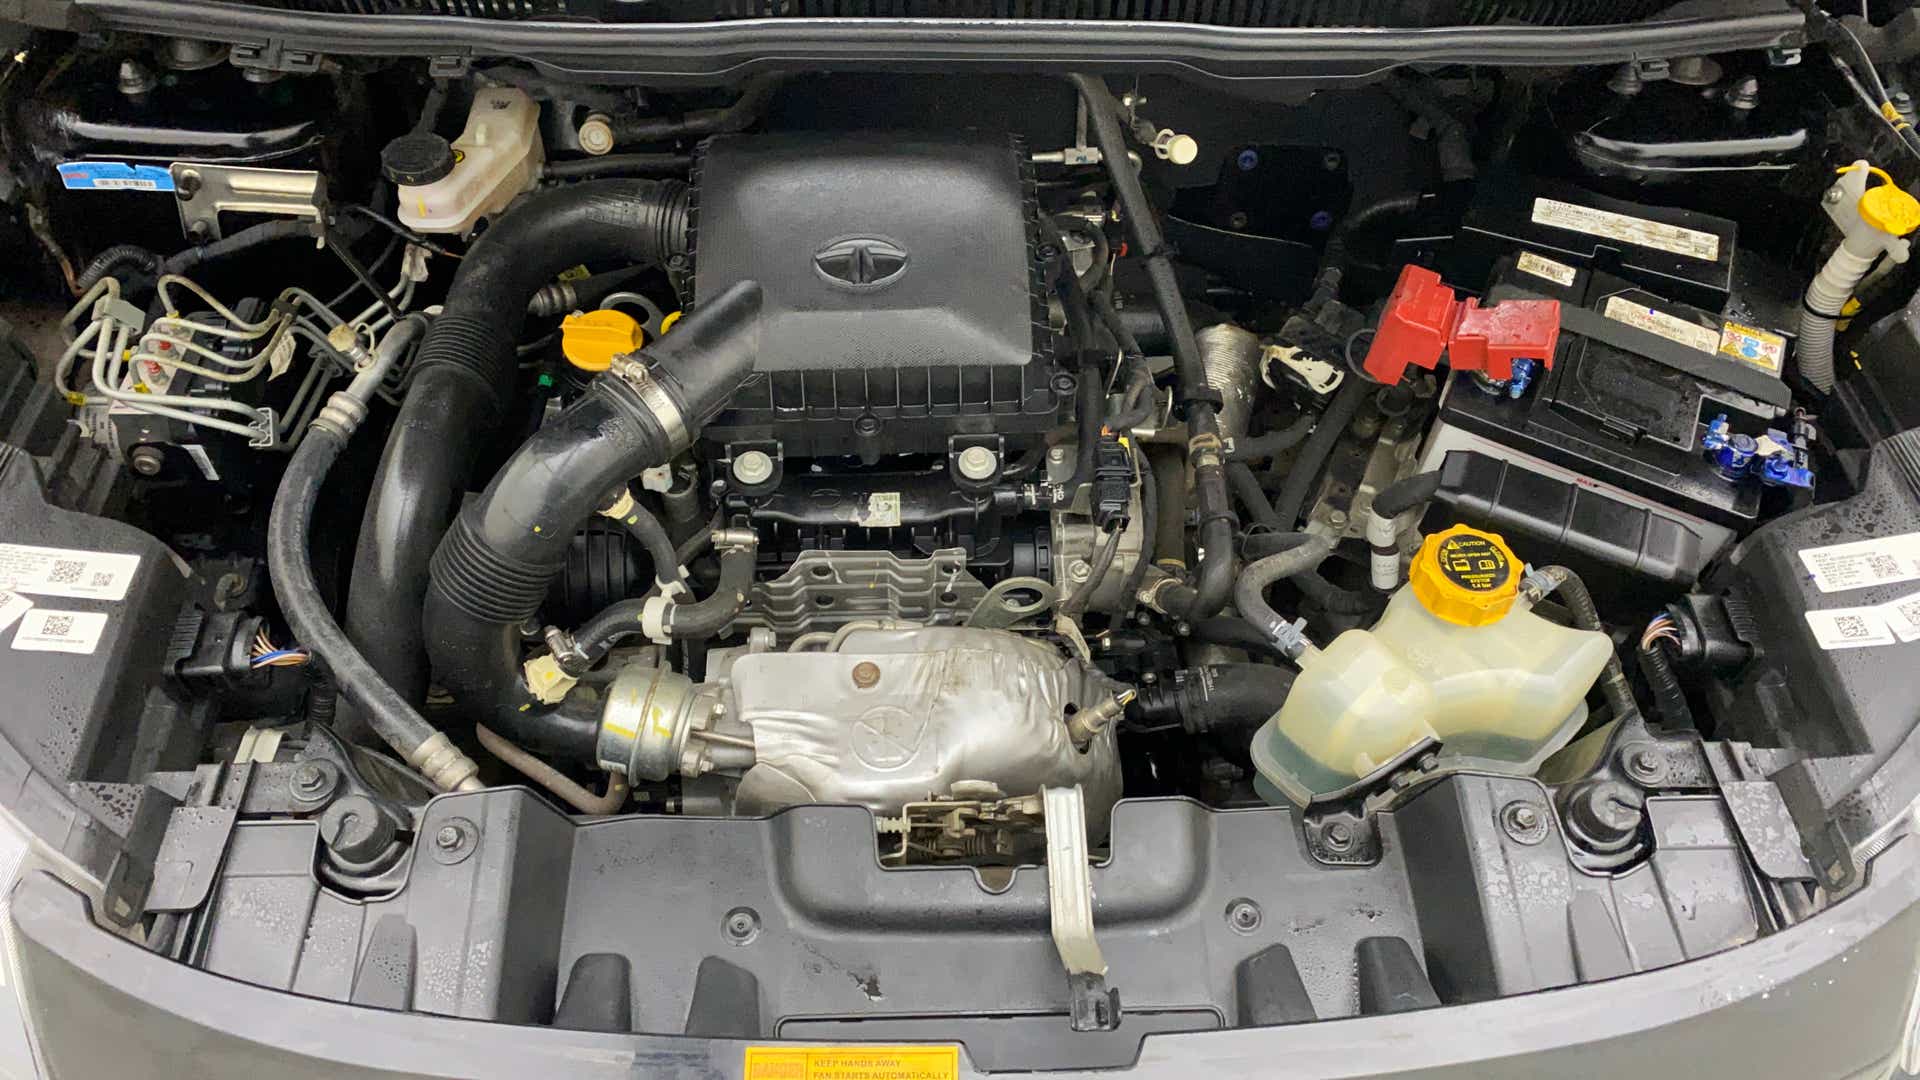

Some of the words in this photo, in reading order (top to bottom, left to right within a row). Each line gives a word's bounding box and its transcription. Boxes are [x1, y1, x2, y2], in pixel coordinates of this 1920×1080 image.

[815, 1059, 838, 1067] KEEP
[840, 1059, 873, 1067] HANDS
[875, 1059, 901, 1067] AWAY
[813, 1071, 831, 1080] FAN
[834, 1071, 870, 1080] STARTS
[872, 1071, 949, 1080] AUTOMATICALLY
